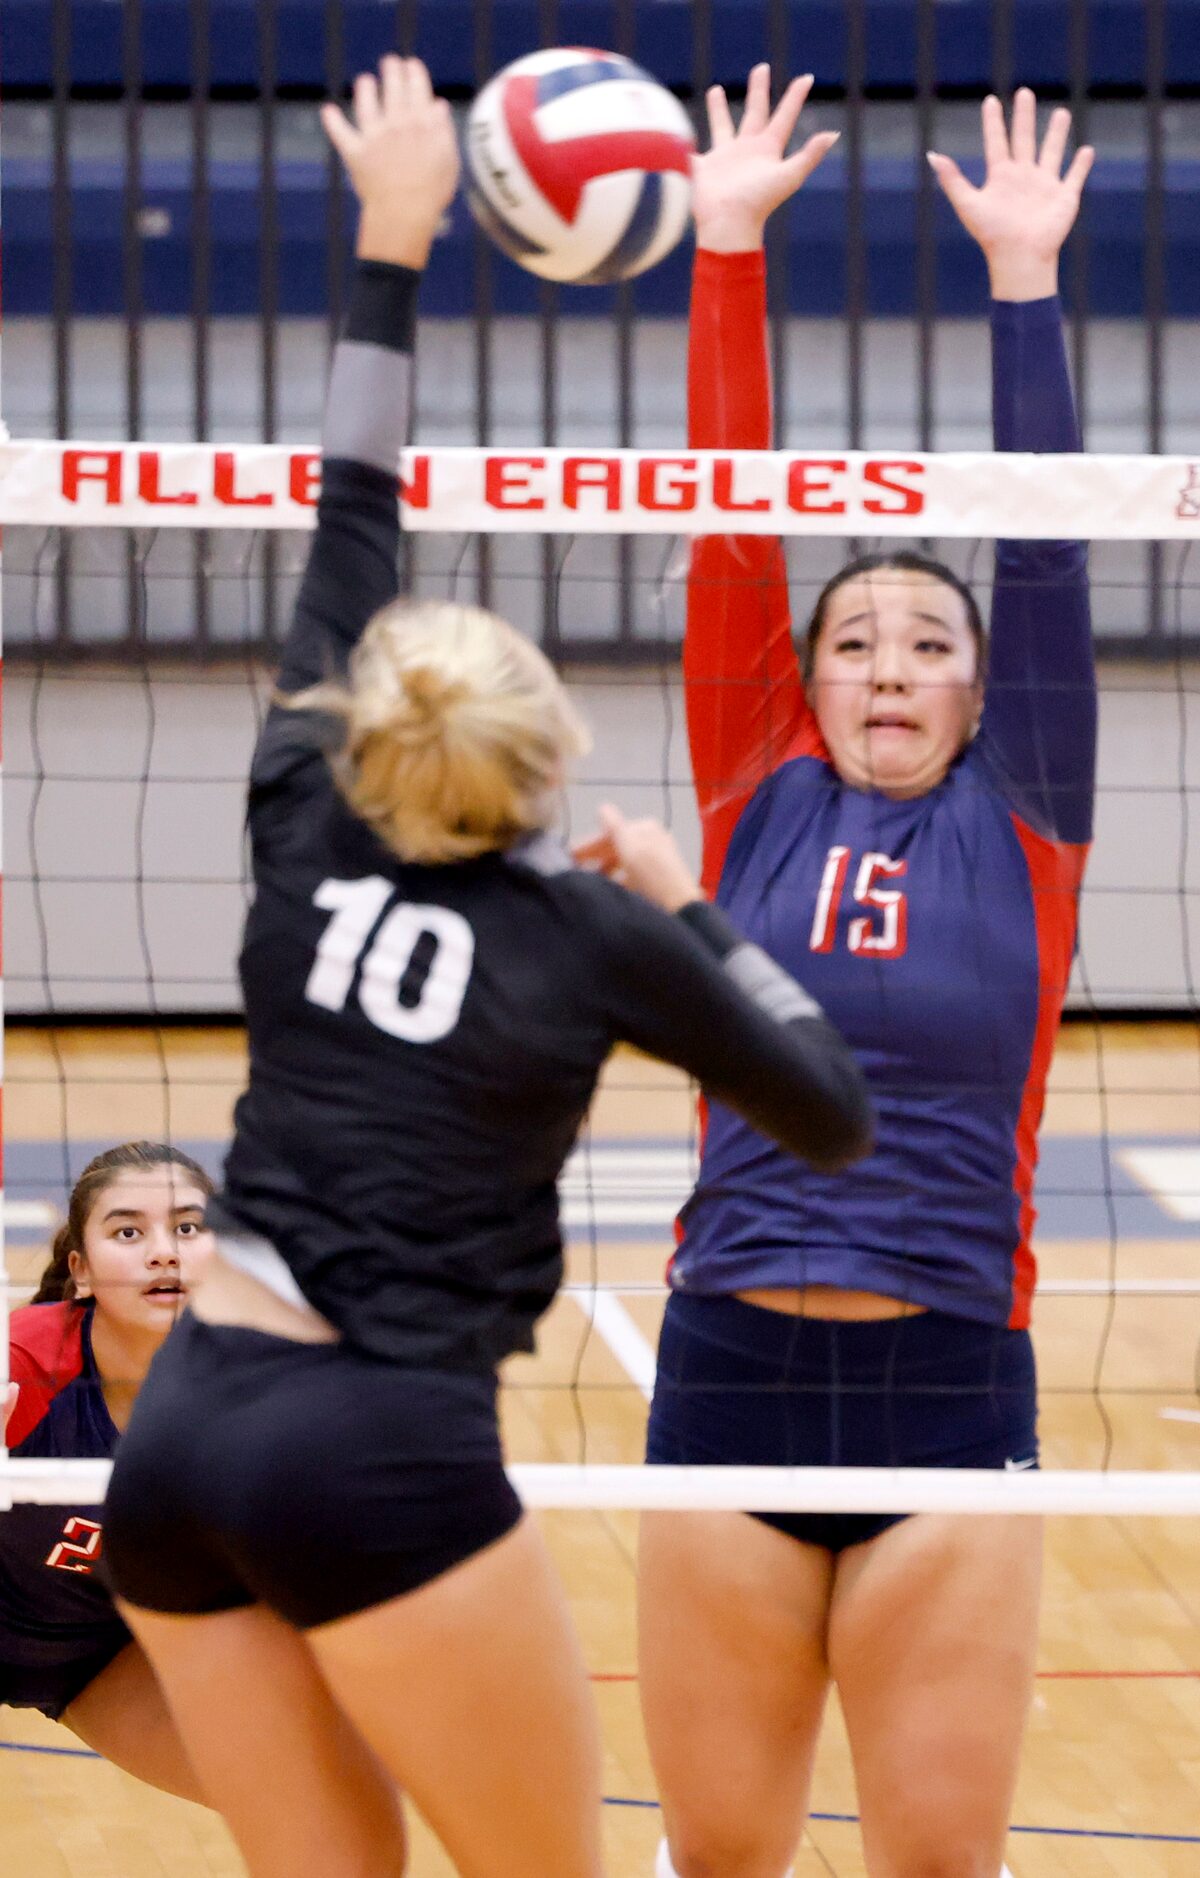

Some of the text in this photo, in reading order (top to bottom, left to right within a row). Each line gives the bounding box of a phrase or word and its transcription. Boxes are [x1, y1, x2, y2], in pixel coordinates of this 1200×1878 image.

[484, 456, 925, 514] EAGLES
[304, 873, 476, 1044] 10
[808, 845, 909, 960] 15
